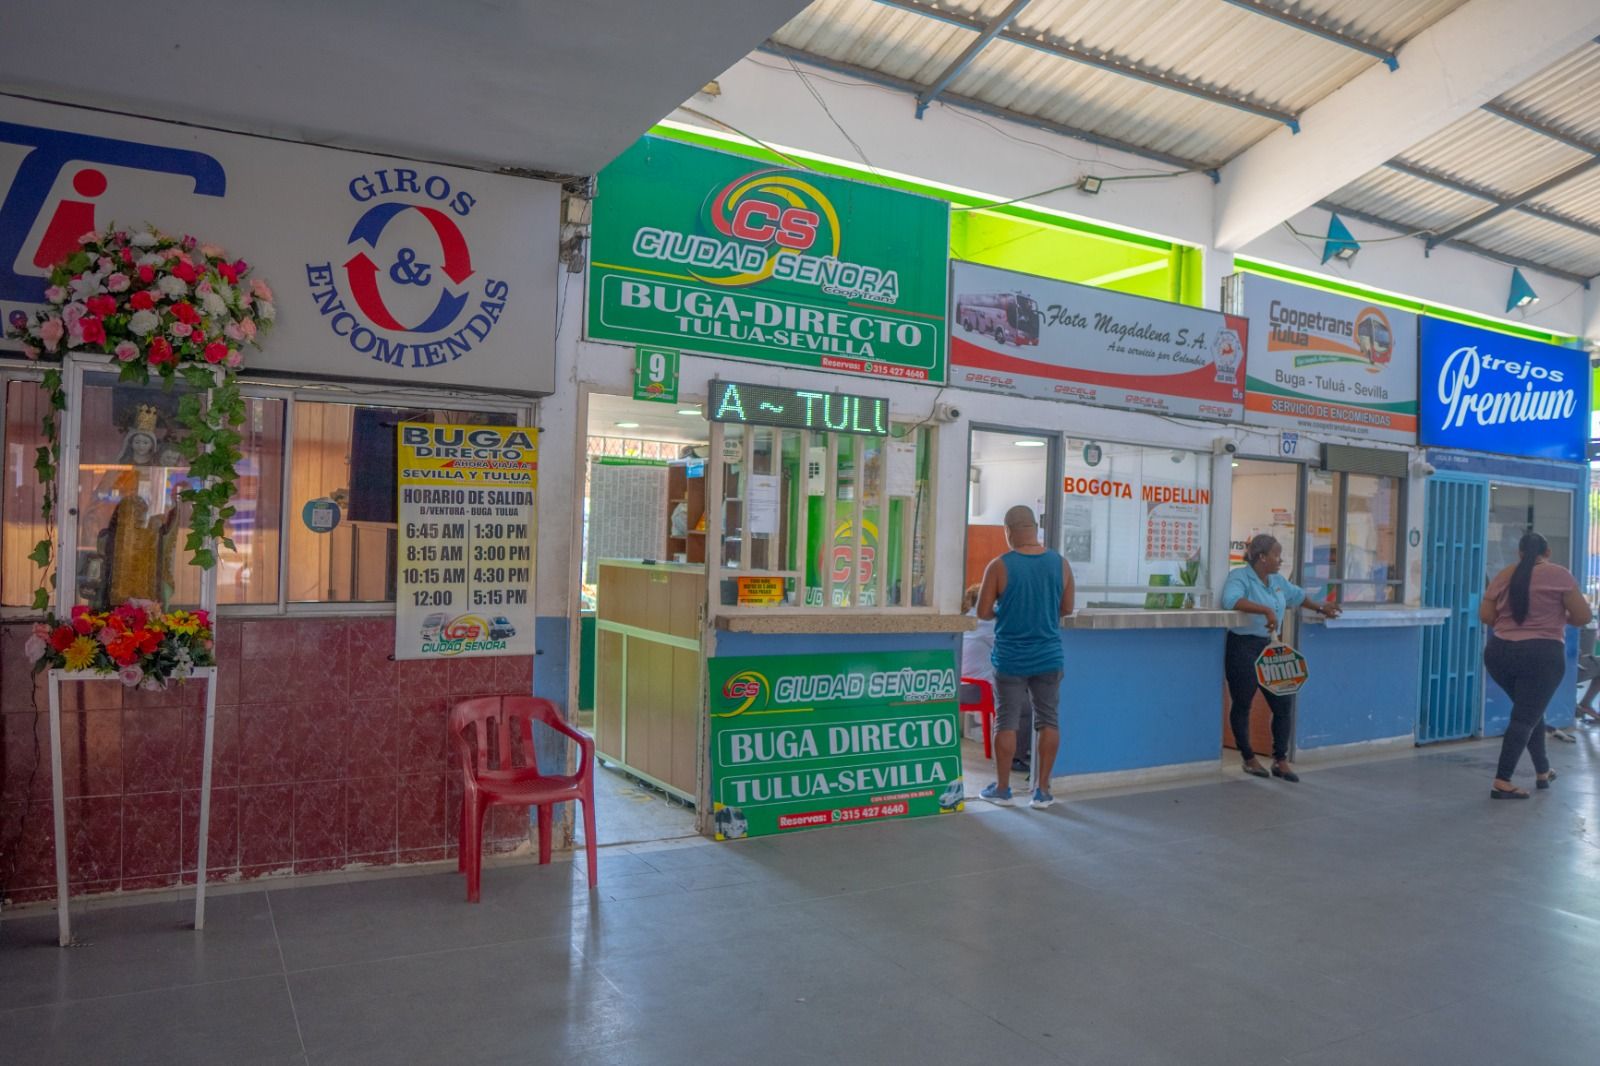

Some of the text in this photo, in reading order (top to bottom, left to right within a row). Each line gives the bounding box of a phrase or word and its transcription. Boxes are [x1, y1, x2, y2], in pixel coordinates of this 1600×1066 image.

[349, 168, 476, 216] GIROS
[731, 199, 820, 249] CS
[389, 248, 431, 286] &
[633, 227, 899, 299] CIUDAD SEÑORA
[305, 261, 509, 368] ENCOMIENDAS
[621, 281, 922, 347] BUGA-DIRECTO
[1269, 300, 1353, 336] Coopetrans
[674, 315, 875, 357] TULUA-SEVILLA
[1047, 304, 1208, 350] Flota Magdalena S.A.
[1127, 346, 1155, 357] servicio
[649, 353, 666, 383] 9
[822, 357, 861, 370] Reservas:
[873, 364, 888, 374] 315
[889, 367, 904, 377] 427
[905, 370, 925, 379] 4640
[1482, 354, 1564, 382] trejos
[1275, 369, 1306, 388] Buga
[1315, 375, 1345, 392] Tuluá
[1354, 382, 1388, 399] Sevilla
[1438, 346, 1577, 431] Premium
[716, 384, 746, 420] A
[1271, 400, 1391, 425] SERVICIO DE ENCOMIENDAS
[403, 427, 533, 449] BUGA
[1283, 440, 1296, 454] 07
[416, 446, 521, 460] DIRECTO
[453, 460, 489, 468] AHORA
[403, 469, 531, 481] SEVILLA Y TULUA
[404, 489, 533, 505] HORARIO DE SALIDA
[1063, 476, 1210, 505] BOGOTA MEDELLIN
[420, 506, 465, 516] B/VENTURA
[471, 507, 492, 516] BUGA
[496, 507, 518, 516] TULUA
[406, 523, 464, 539] 6:45 AM
[474, 523, 528, 539] 1:30 PM
[407, 546, 463, 561] 8:15 AM
[474, 546, 530, 561] 3:00 PM
[403, 568, 465, 584] 10:15 AM
[473, 568, 529, 583] 4:30 PM
[412, 590, 452, 606] 12:00
[473, 589, 527, 605] 5:15 PM
[451, 625, 481, 639] CS
[421, 643, 461, 653] CIUDAD
[730, 682, 760, 698] CS
[775, 667, 956, 703] CIUDAD SEÑORA
[731, 719, 953, 764] BUGA DIRECTO
[731, 762, 947, 803] TULUA-SEVILLA
[780, 804, 904, 827] Reservas: 315 427 4640
